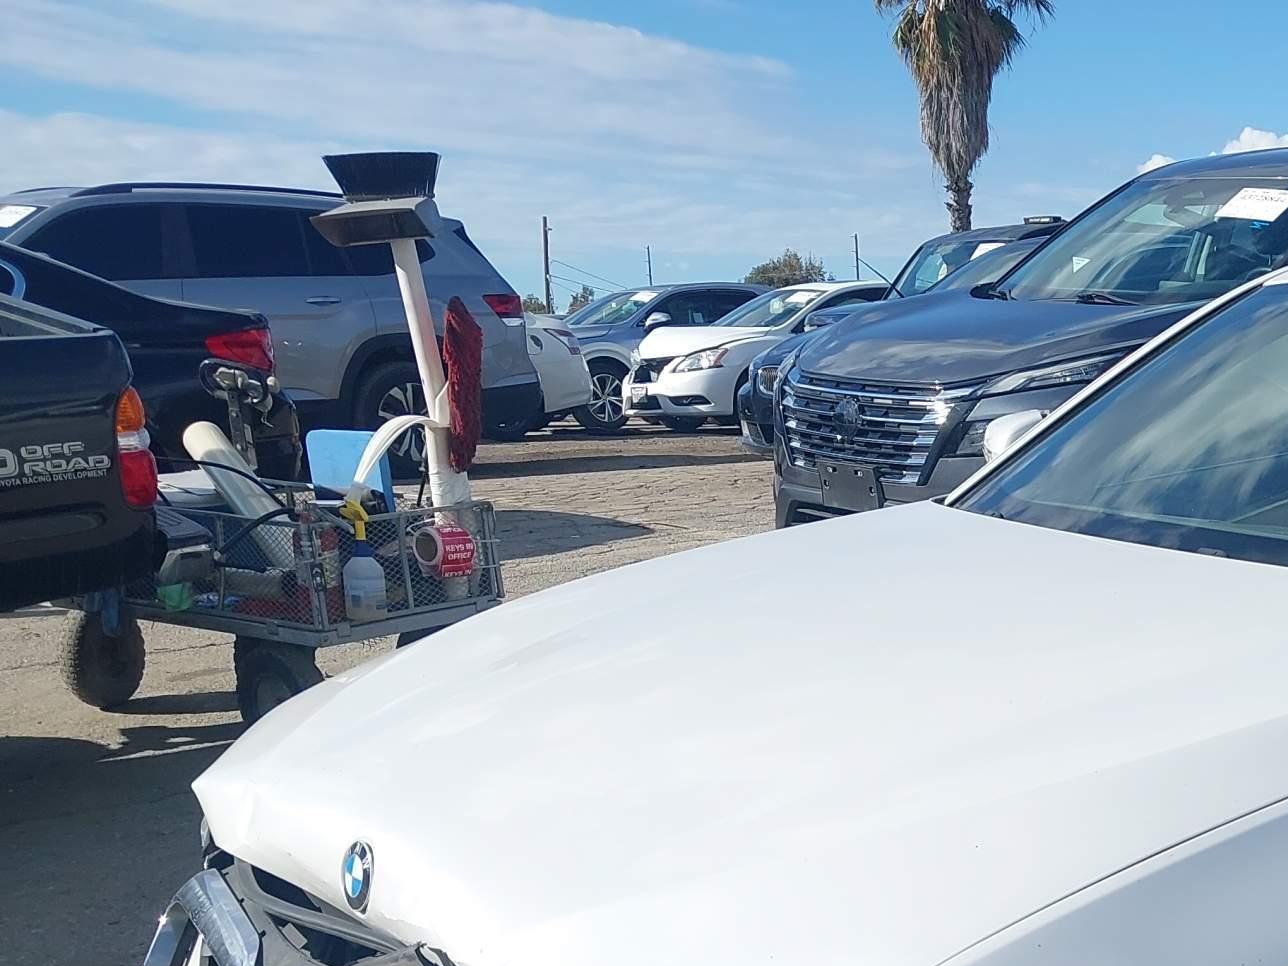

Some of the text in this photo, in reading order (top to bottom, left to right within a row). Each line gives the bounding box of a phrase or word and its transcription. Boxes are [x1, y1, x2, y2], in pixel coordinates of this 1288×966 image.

[20, 441, 85, 459] OFF
[23, 454, 112, 477] ROAD
[0, 468, 108, 488] YOTA RACING DEVELOPMENT
[445, 542, 474, 552] KEYS IN
[447, 551, 472, 561] OFFICE
